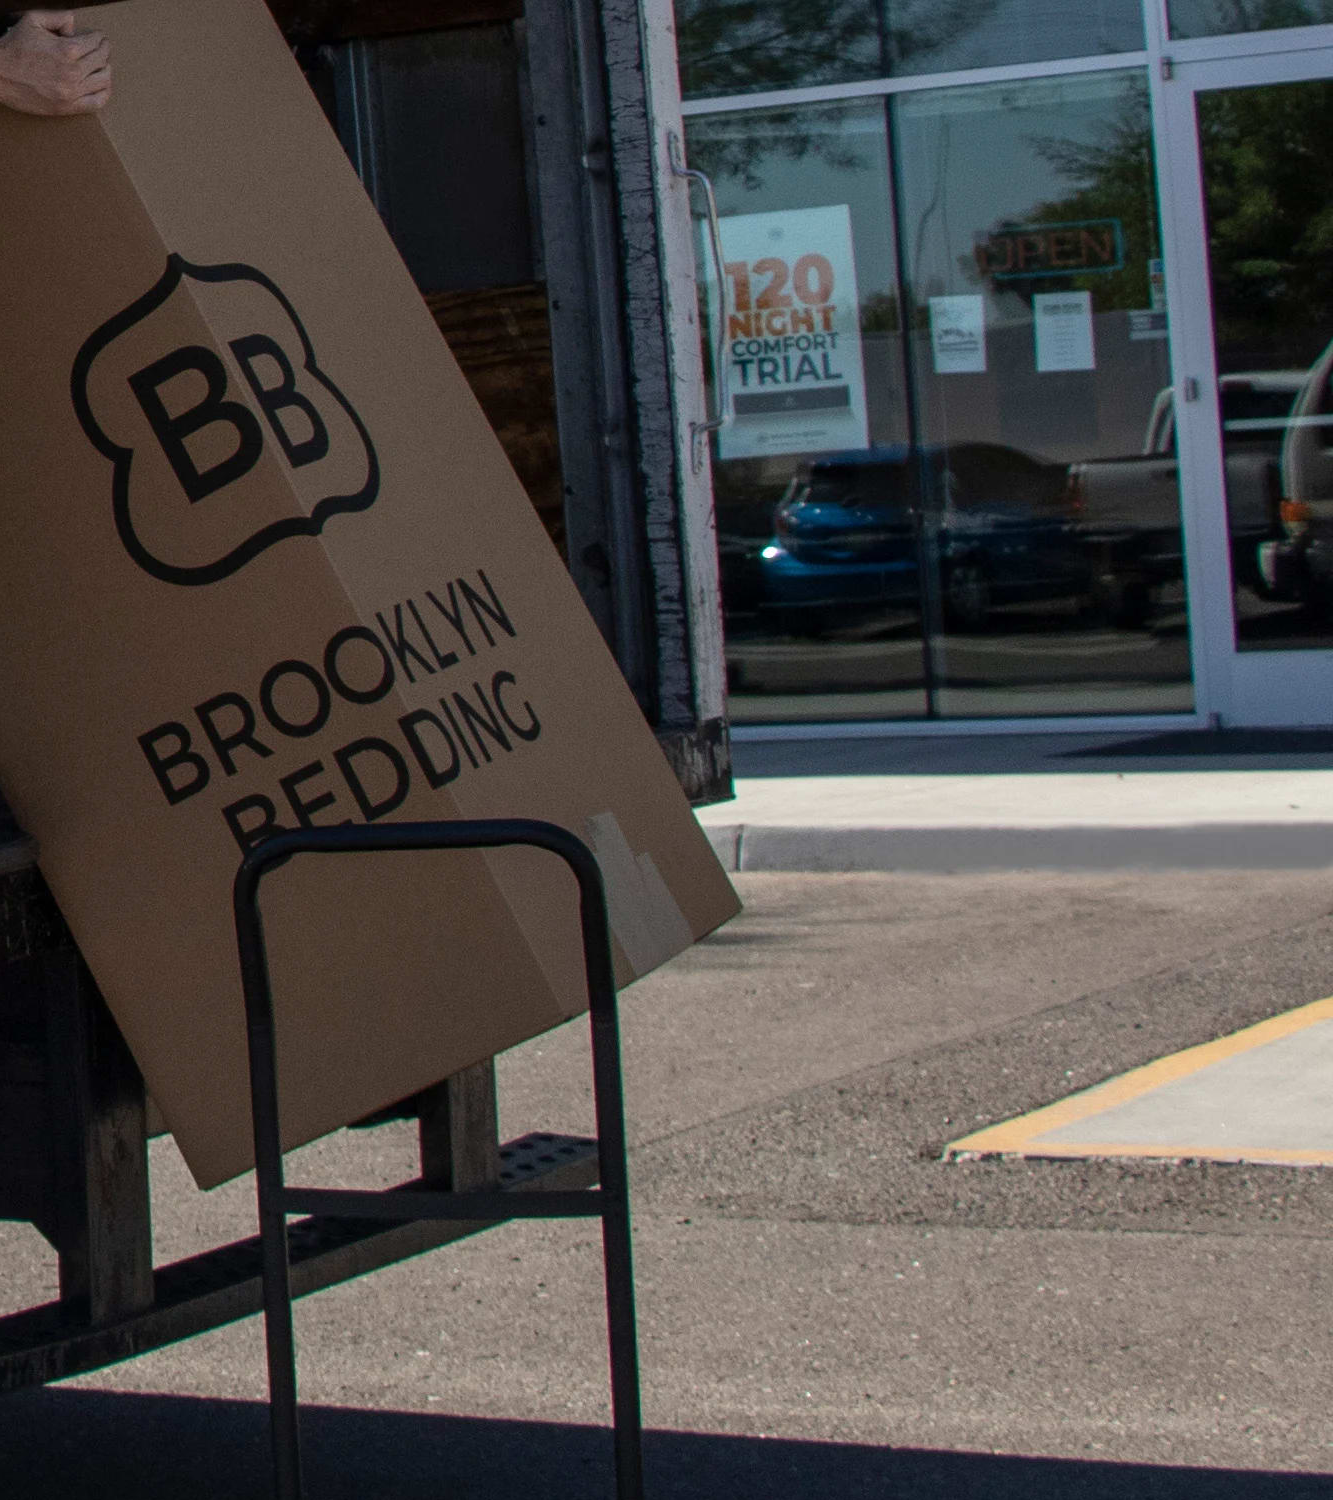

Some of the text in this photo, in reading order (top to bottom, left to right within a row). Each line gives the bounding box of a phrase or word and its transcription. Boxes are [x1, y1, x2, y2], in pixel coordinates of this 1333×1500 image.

[724, 252, 835, 313] 120
[728, 304, 837, 341] NIGHT
[730, 331, 840, 359] COMFORT
[732, 350, 843, 387] TRIAL
[126, 332, 331, 506] BB
[137, 568, 518, 807] BROOKLYN
